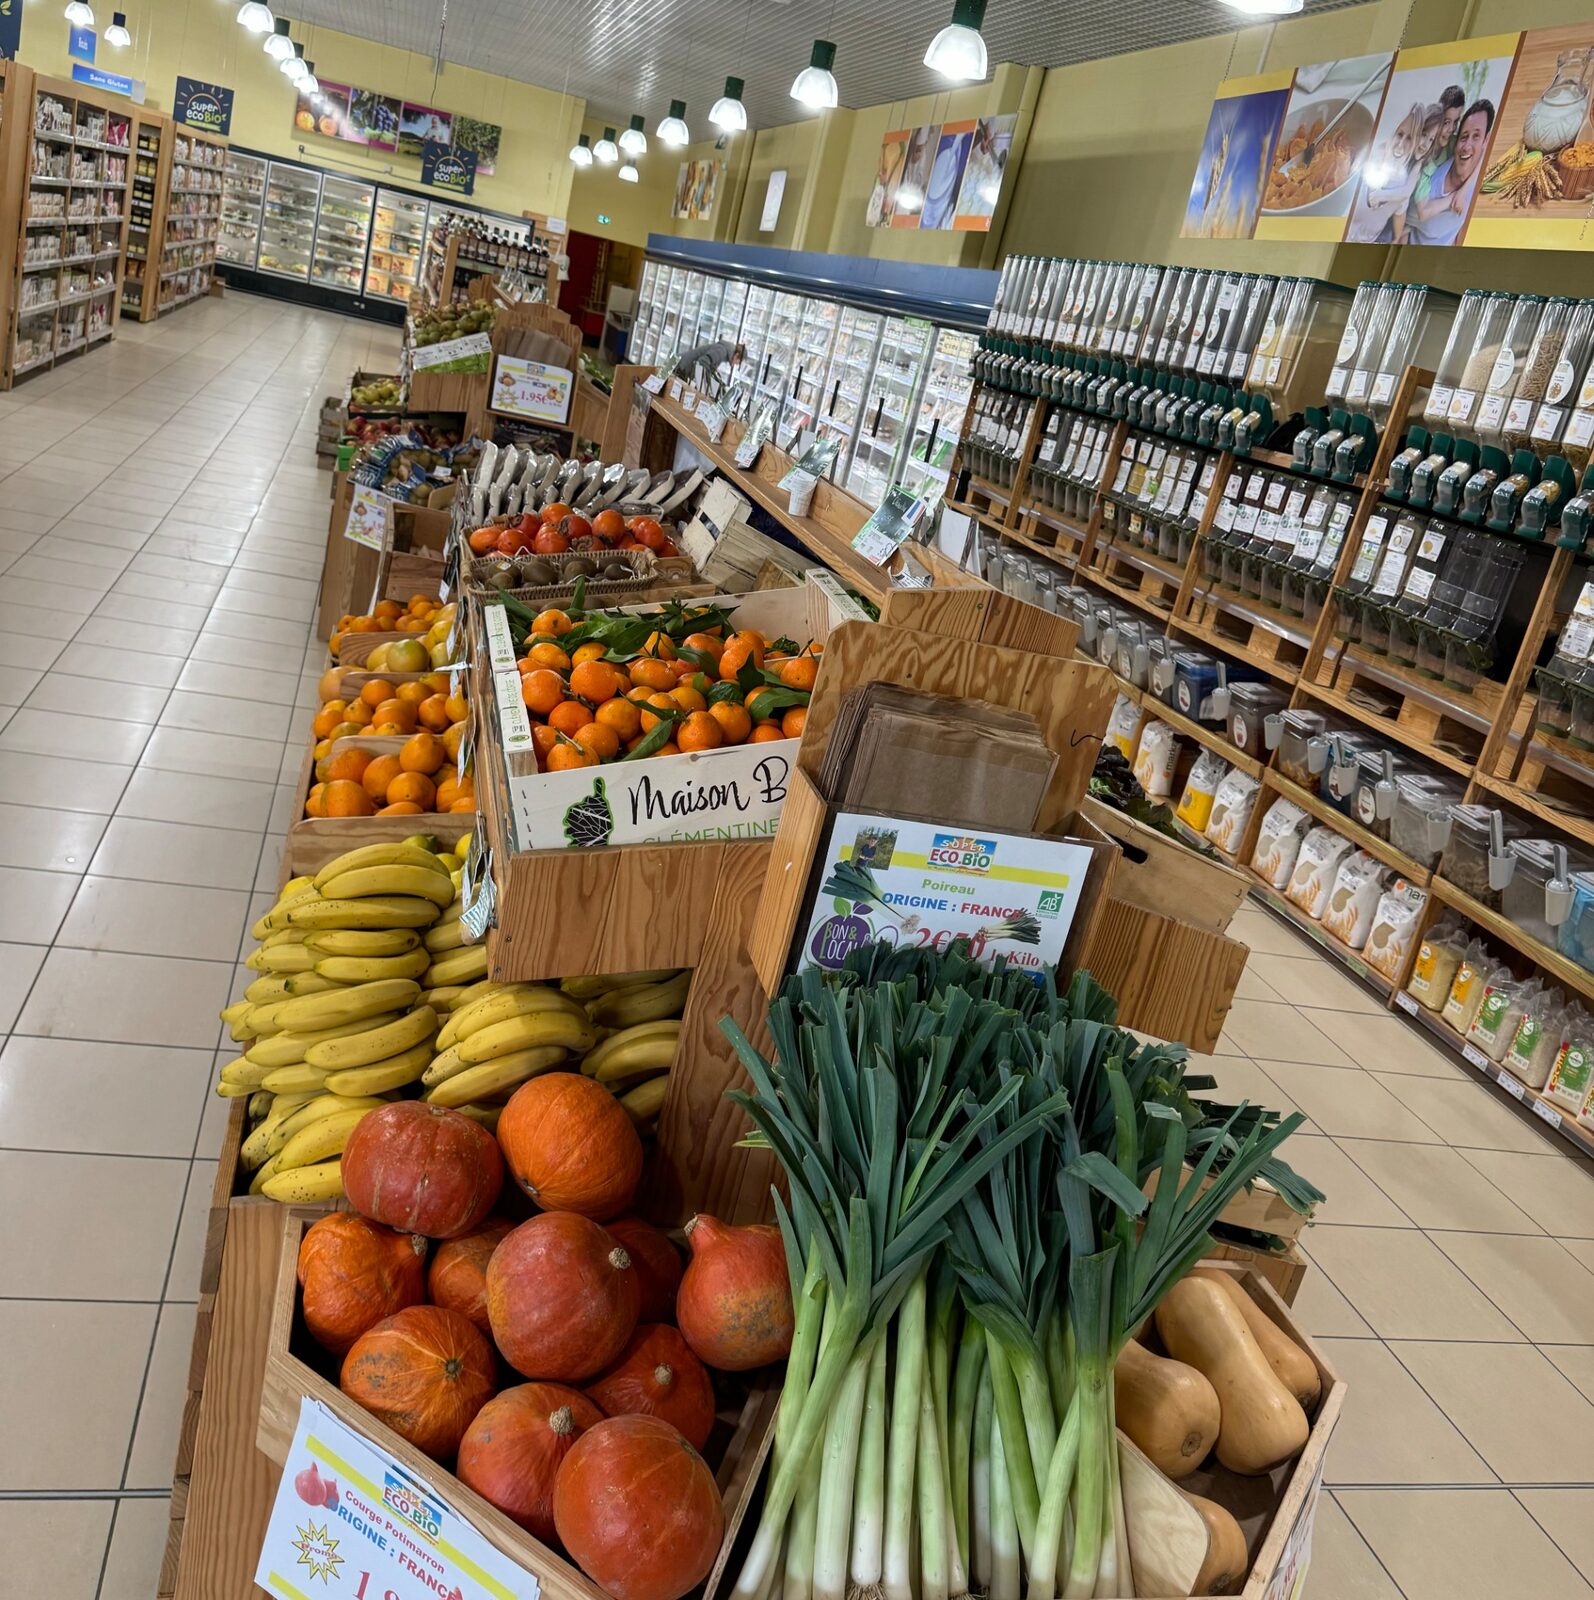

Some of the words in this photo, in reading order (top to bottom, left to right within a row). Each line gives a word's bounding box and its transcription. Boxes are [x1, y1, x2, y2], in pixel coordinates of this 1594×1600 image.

[191, 101, 218, 113] super
[628, 775, 751, 826] Maison
[921, 878, 976, 896] Poireau
[881, 892, 949, 911] ORIGINE
[1038, 897, 1058, 911] AB
[329, 1499, 388, 1551] ORIGINE
[345, 1490, 383, 1525] Courge
[385, 1520, 445, 1574] Potimarron
